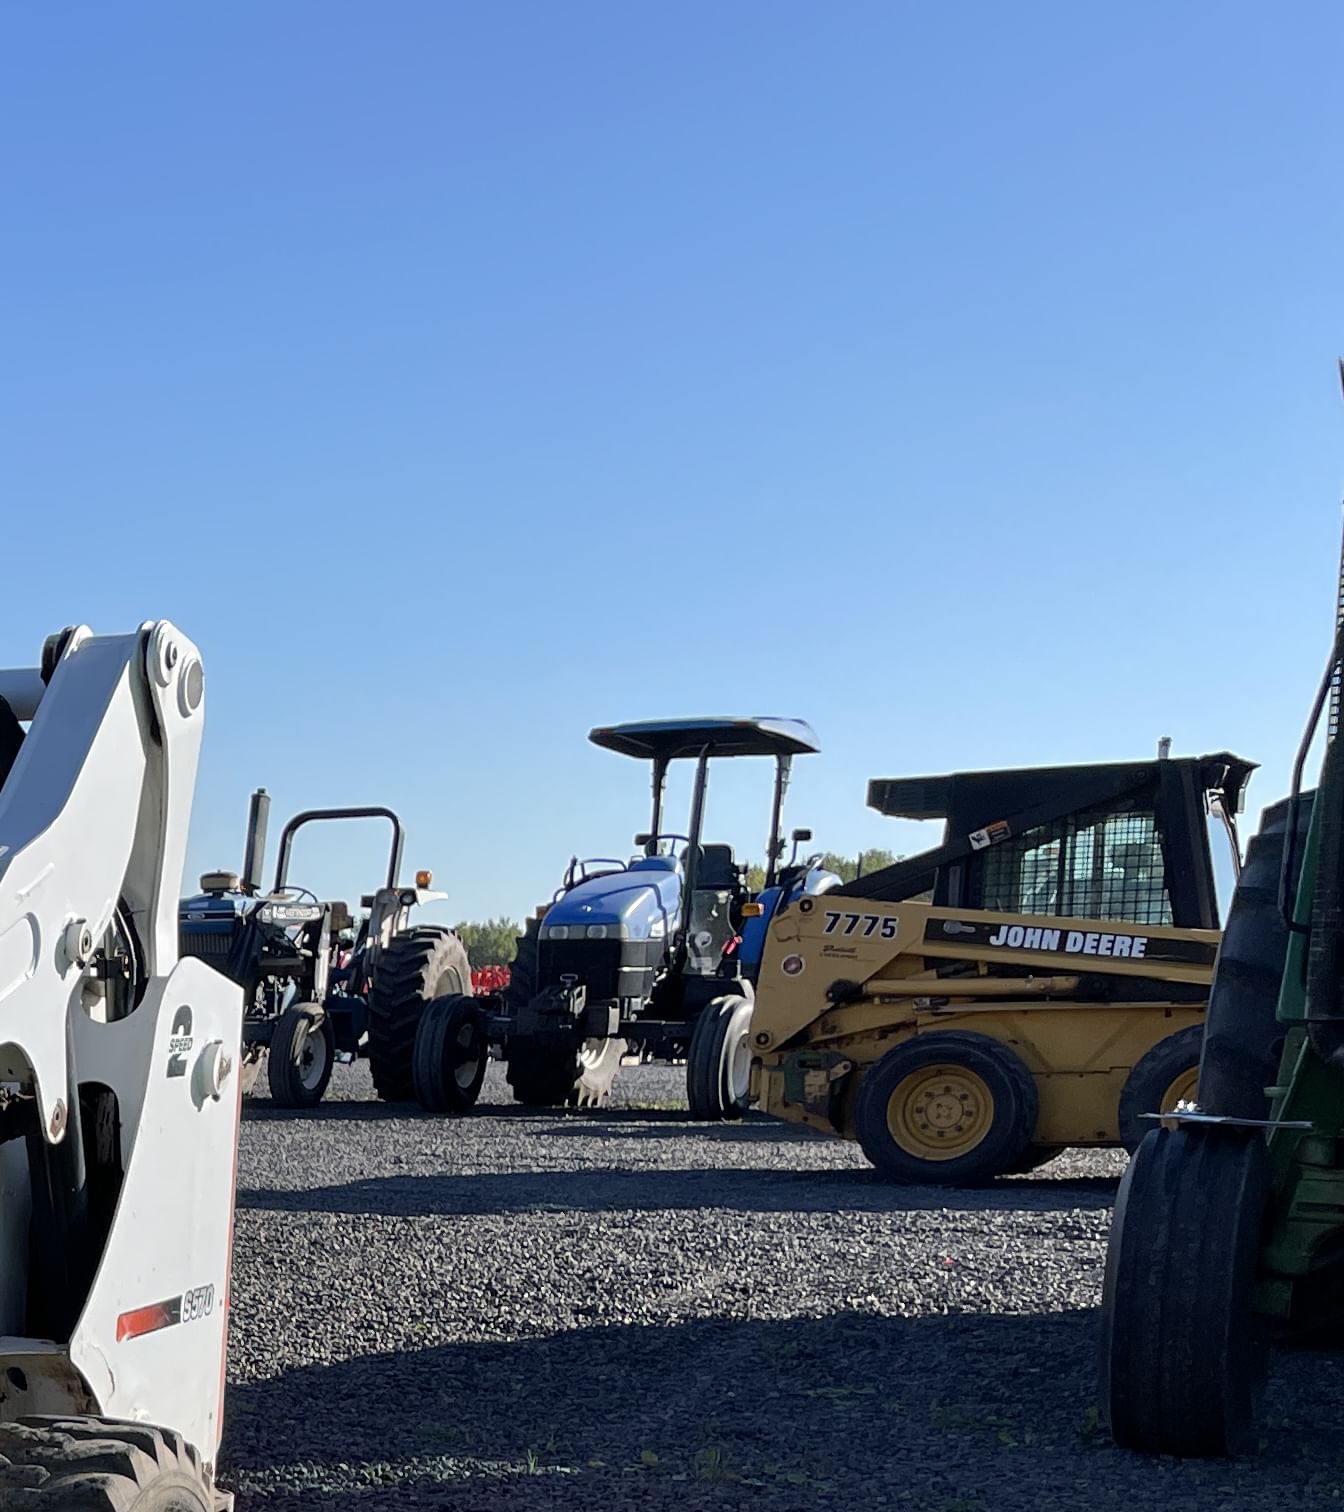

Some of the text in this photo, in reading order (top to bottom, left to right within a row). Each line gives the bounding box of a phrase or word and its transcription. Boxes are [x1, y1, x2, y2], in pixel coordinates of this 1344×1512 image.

[823, 911, 899, 940] 7775
[989, 925, 1148, 958] JOHN DEERE
[166, 1004, 193, 1079] 2
[169, 1037, 193, 1053] SPEED
[183, 1283, 215, 1323] S570
